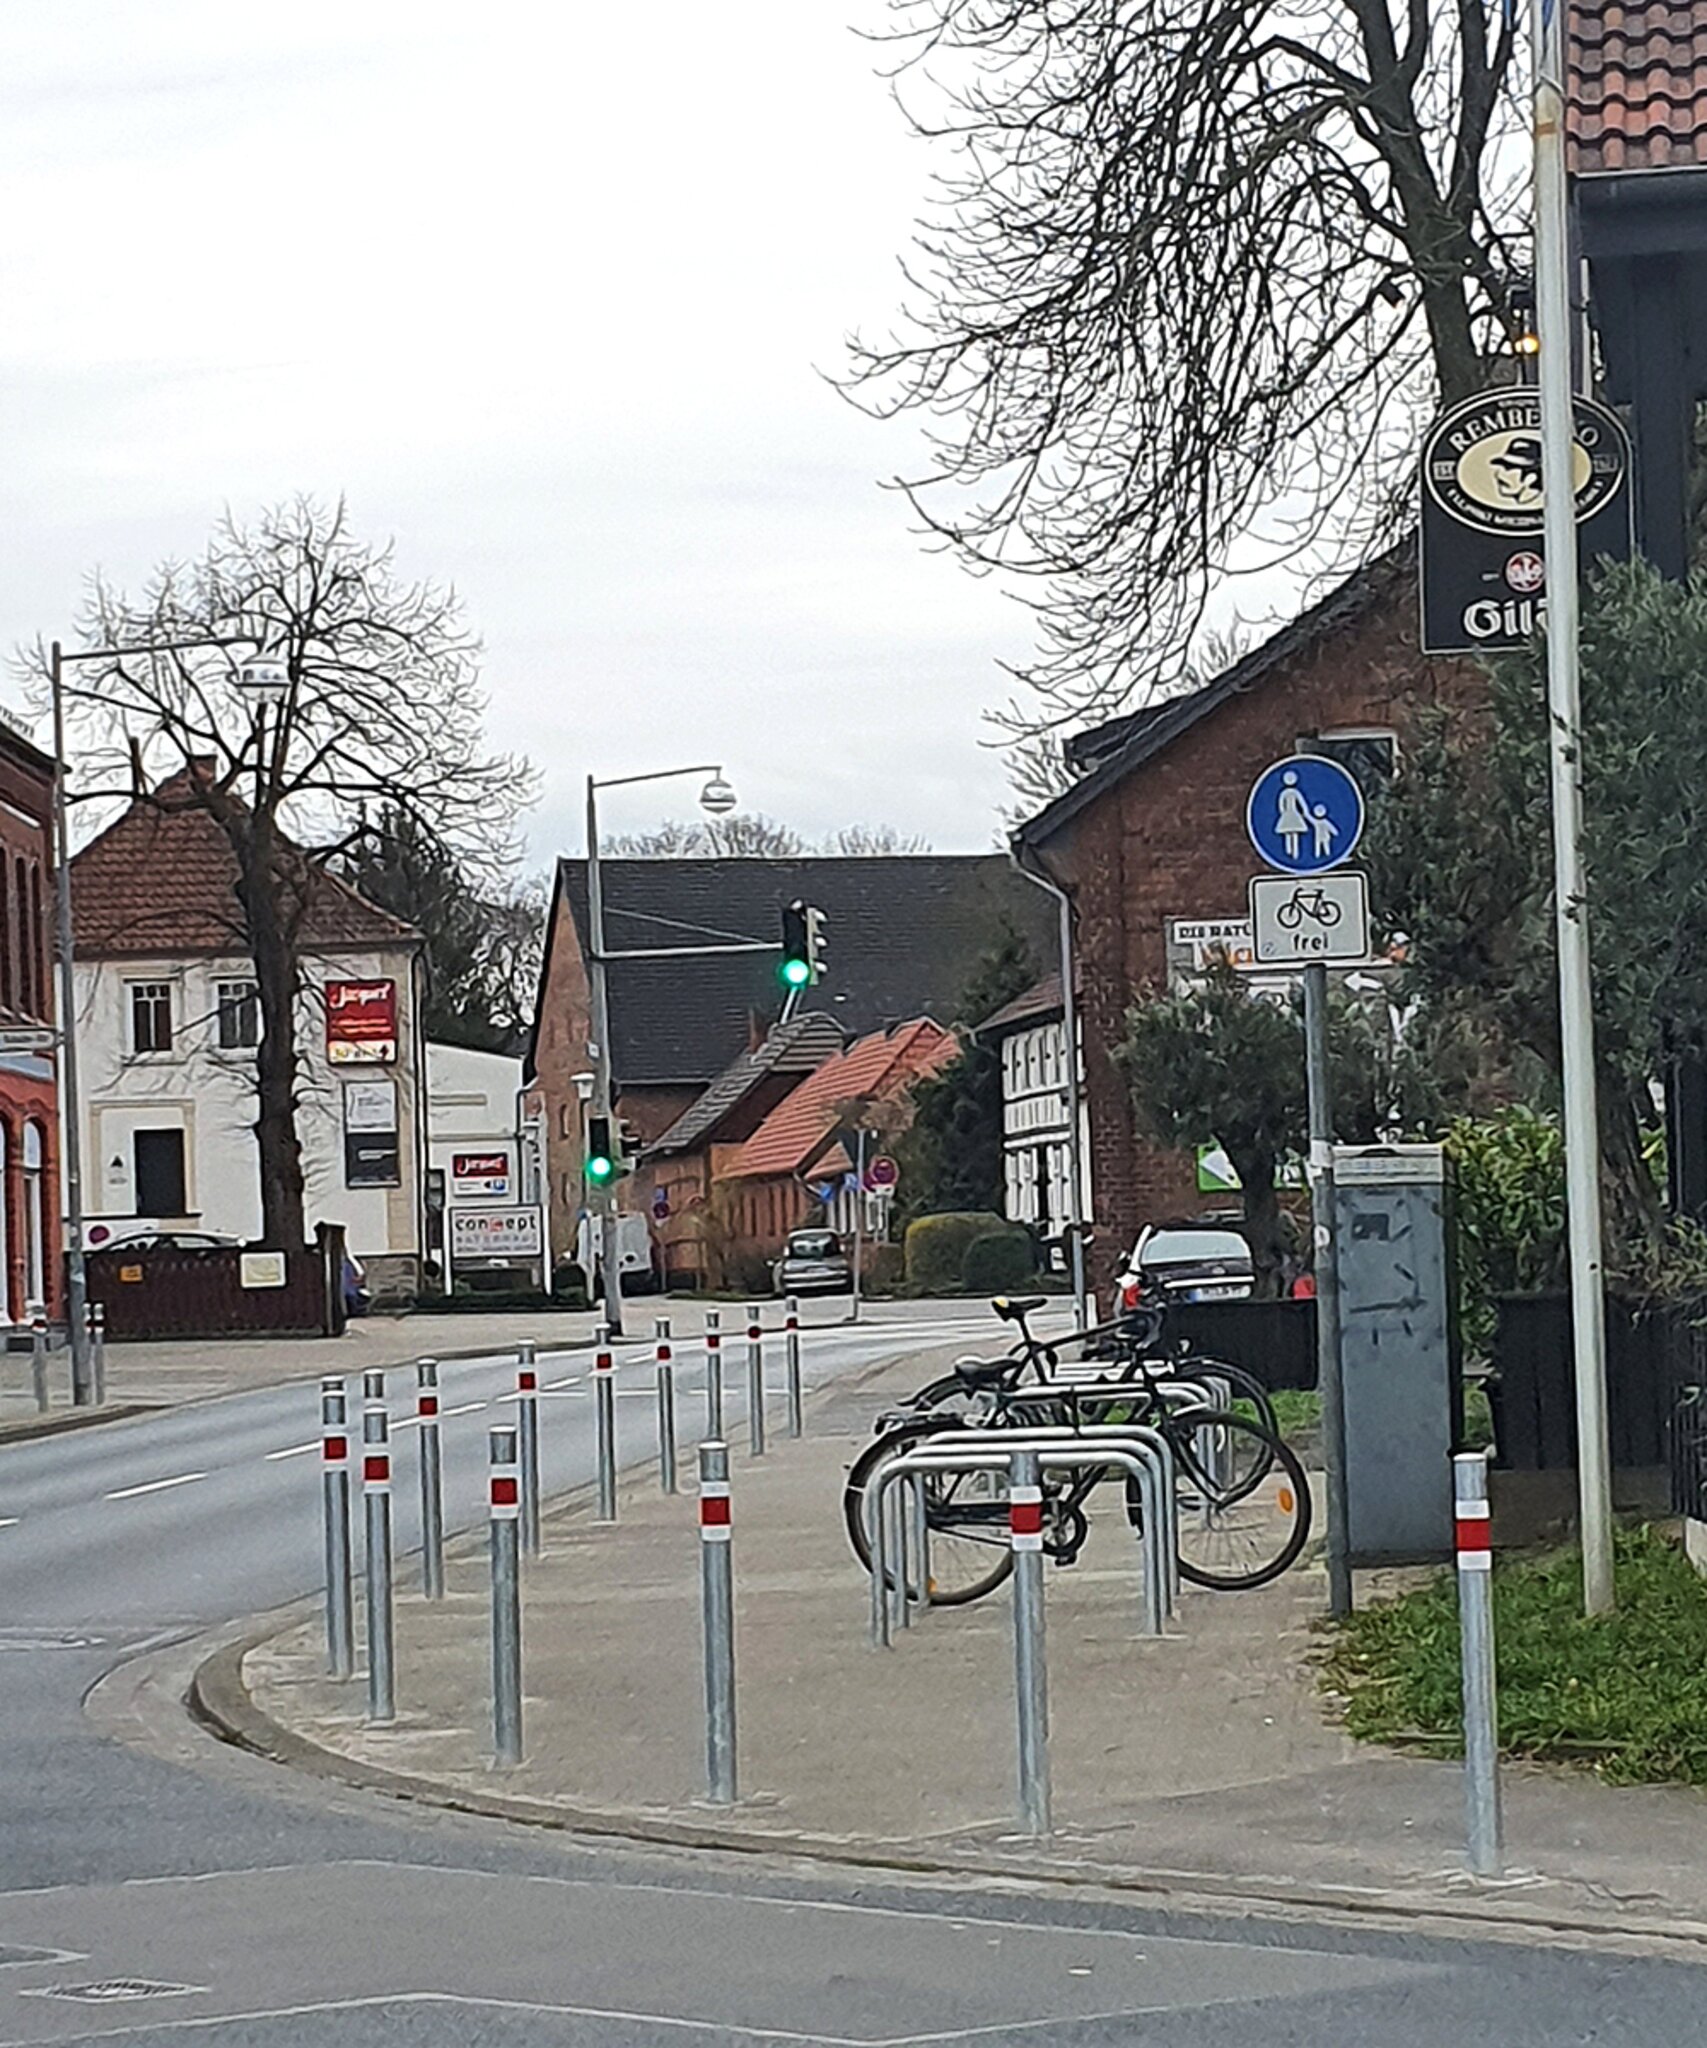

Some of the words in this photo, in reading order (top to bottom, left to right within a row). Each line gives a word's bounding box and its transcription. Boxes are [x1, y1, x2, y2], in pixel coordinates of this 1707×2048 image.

[1449, 407, 1599, 452] REMBEO
[1463, 600, 1548, 638] Gil
[1293, 931, 1328, 951] frei
